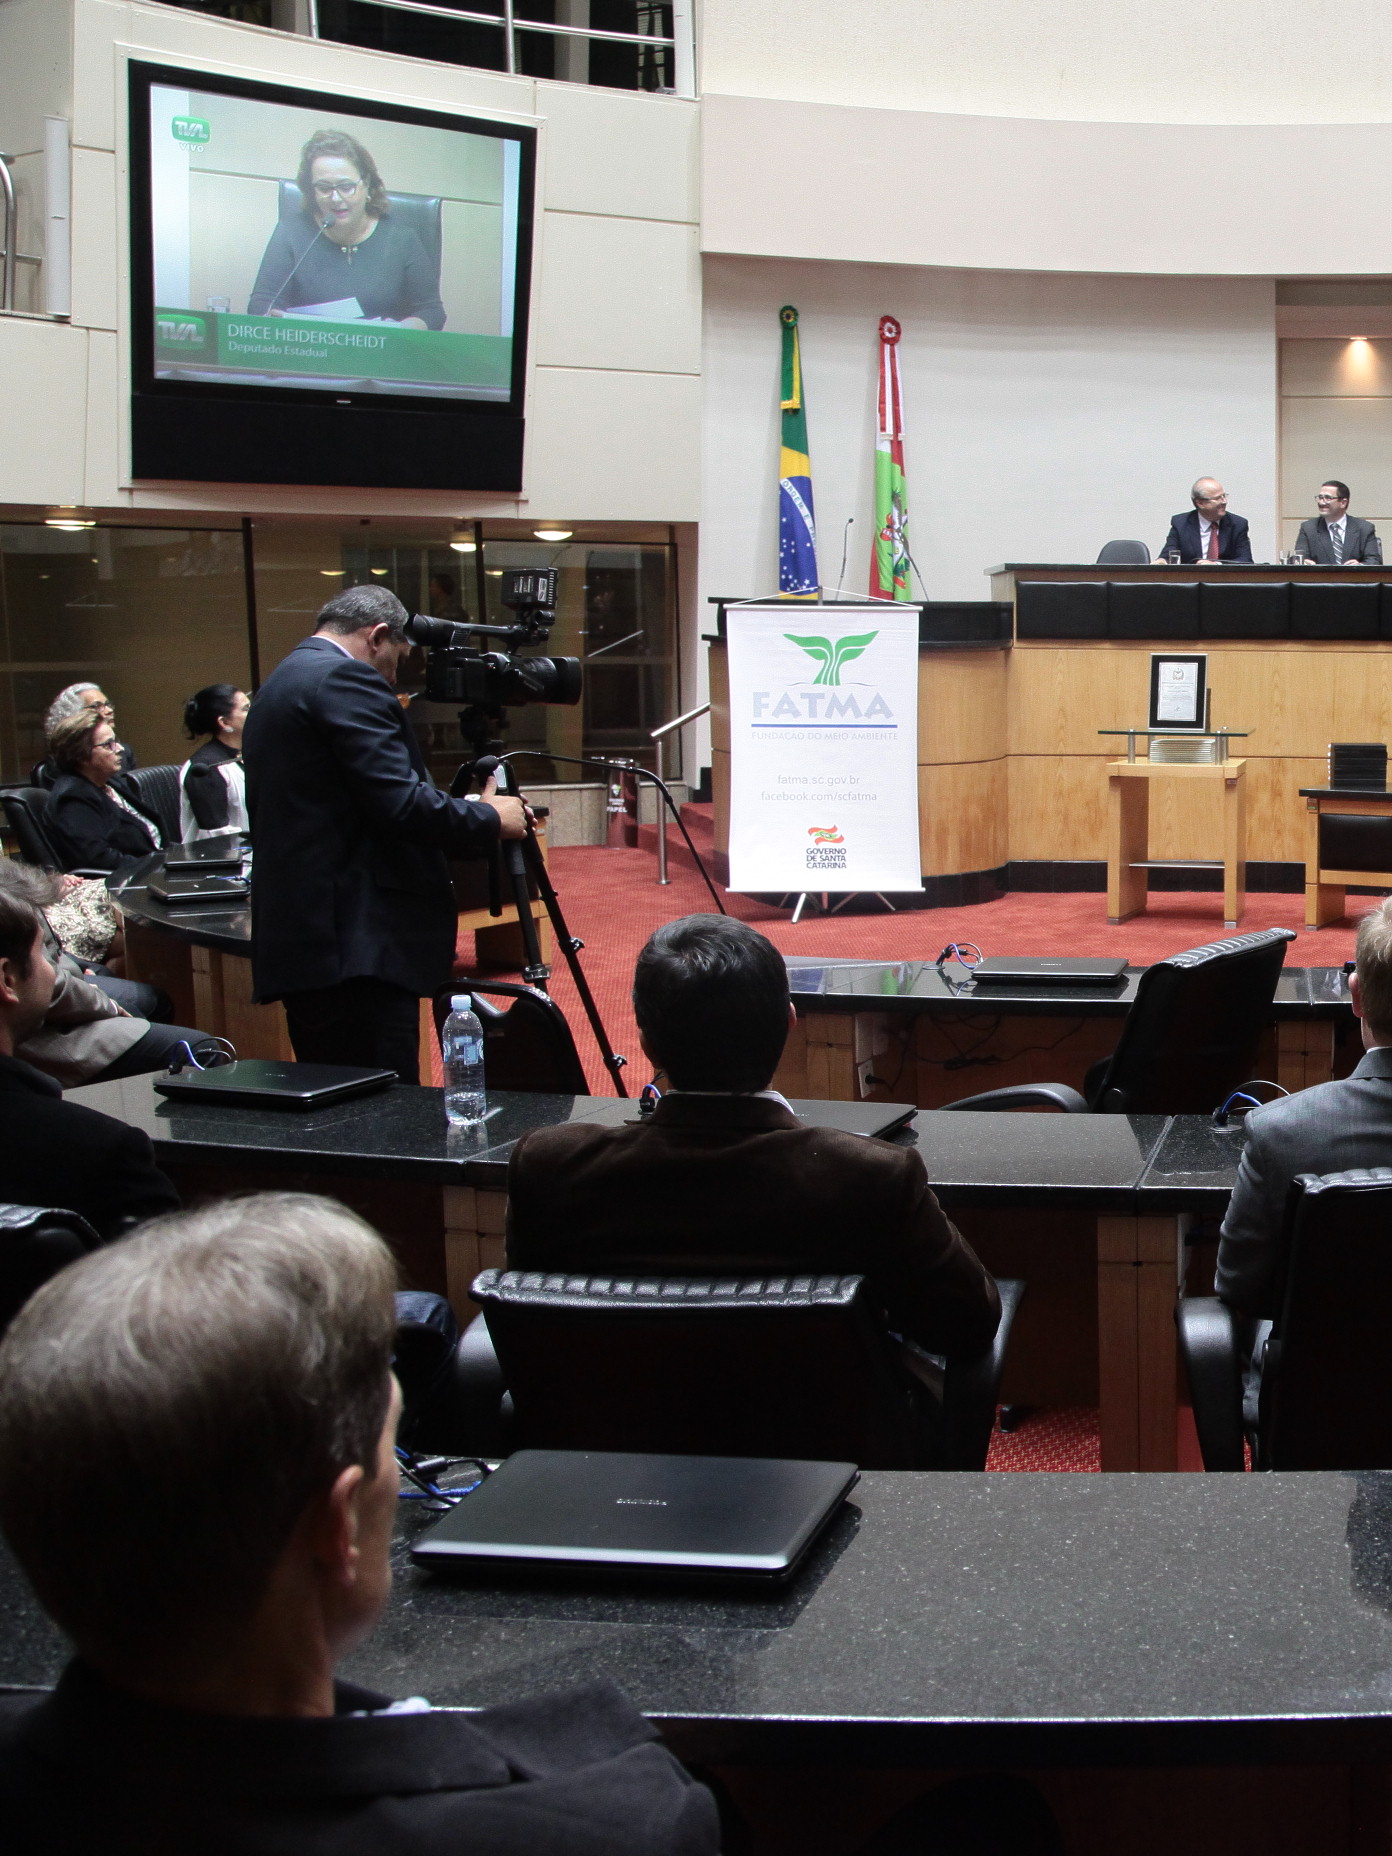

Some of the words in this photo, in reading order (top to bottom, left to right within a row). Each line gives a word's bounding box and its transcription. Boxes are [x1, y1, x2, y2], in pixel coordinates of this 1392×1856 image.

[228, 323, 271, 340] DIRCE
[275, 329, 387, 349] HEIDERSCHEIDT
[228, 341, 282, 355] Deputado
[284, 346, 328, 358] Estadual
[752, 691, 894, 719] FATMA
[807, 732, 822, 740] DO
[824, 732, 849, 740] MEIO
[851, 732, 898, 740] AMBIENTE
[777, 774, 861, 787] fatma.sc.gov.br
[761, 791, 878, 802] facebook.com/scfatma
[806, 847, 847, 855] GOVERNO
